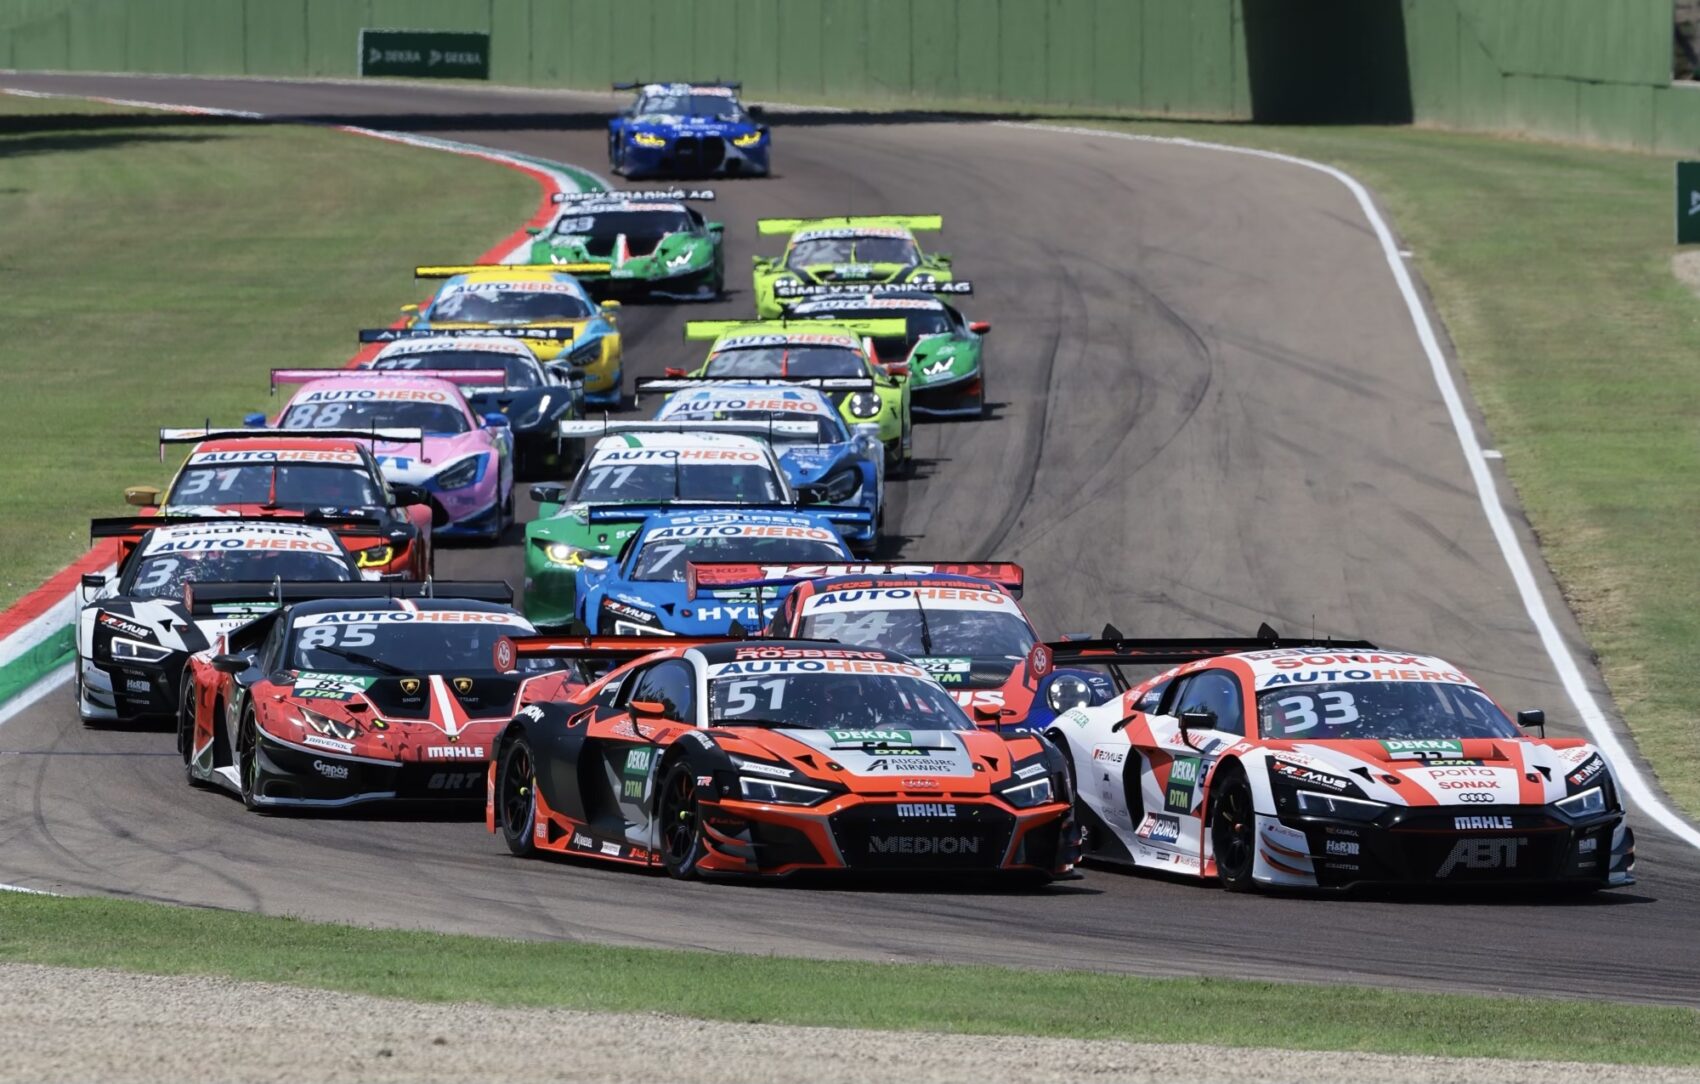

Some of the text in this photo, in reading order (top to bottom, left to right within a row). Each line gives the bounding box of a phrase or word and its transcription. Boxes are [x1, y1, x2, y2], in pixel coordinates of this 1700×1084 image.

[454, 282, 570, 294] AUTOHERO
[777, 281, 971, 296] SIMEX TRADING AG
[725, 333, 852, 348] AUTOHERO
[304, 389, 446, 402] AUTOHERO
[673, 399, 819, 413] AUTOHERO
[288, 403, 346, 428] 88
[198, 451, 357, 462] AUTOHERO
[601, 449, 760, 462] AUTOHERO
[180, 468, 241, 495] 31
[586, 466, 638, 490] 11
[655, 525, 829, 540] AUTOHERO
[152, 538, 334, 553] AUTOHERO
[647, 544, 688, 574] 7
[136, 558, 180, 590] 3
[814, 589, 1005, 608] AUTOHERO
[317, 611, 511, 624] AUTOHERO
[299, 624, 378, 649] 85
[735, 650, 887, 661] ROSBERG
[1271, 654, 1429, 670] SONAX
[716, 660, 922, 677] AUTOHERO
[302, 672, 366, 687] DEKRA
[315, 680, 345, 691] 85
[1264, 669, 1466, 687] AUTOHERO
[298, 689, 345, 700] DTM
[723, 678, 787, 717] 51
[1278, 690, 1360, 735] 33
[309, 737, 350, 750] RAVENOL
[832, 730, 907, 742] DEKRA
[428, 747, 485, 758] MAHLE
[1385, 740, 1458, 751] DEKRA
[626, 750, 650, 772] DEKRA
[890, 758, 956, 767] AUGSBURG
[895, 764, 952, 773] AIRWAYS
[1171, 760, 1197, 783] DEKRA
[1428, 767, 1497, 781] porta
[427, 773, 481, 790] GRT
[624, 780, 643, 798] DTM
[1438, 780, 1502, 790] SONAX
[1168, 789, 1189, 809] DTM
[897, 803, 957, 818] MAHLE
[1454, 816, 1513, 830] MAHLE
[869, 835, 980, 853] MEDION
